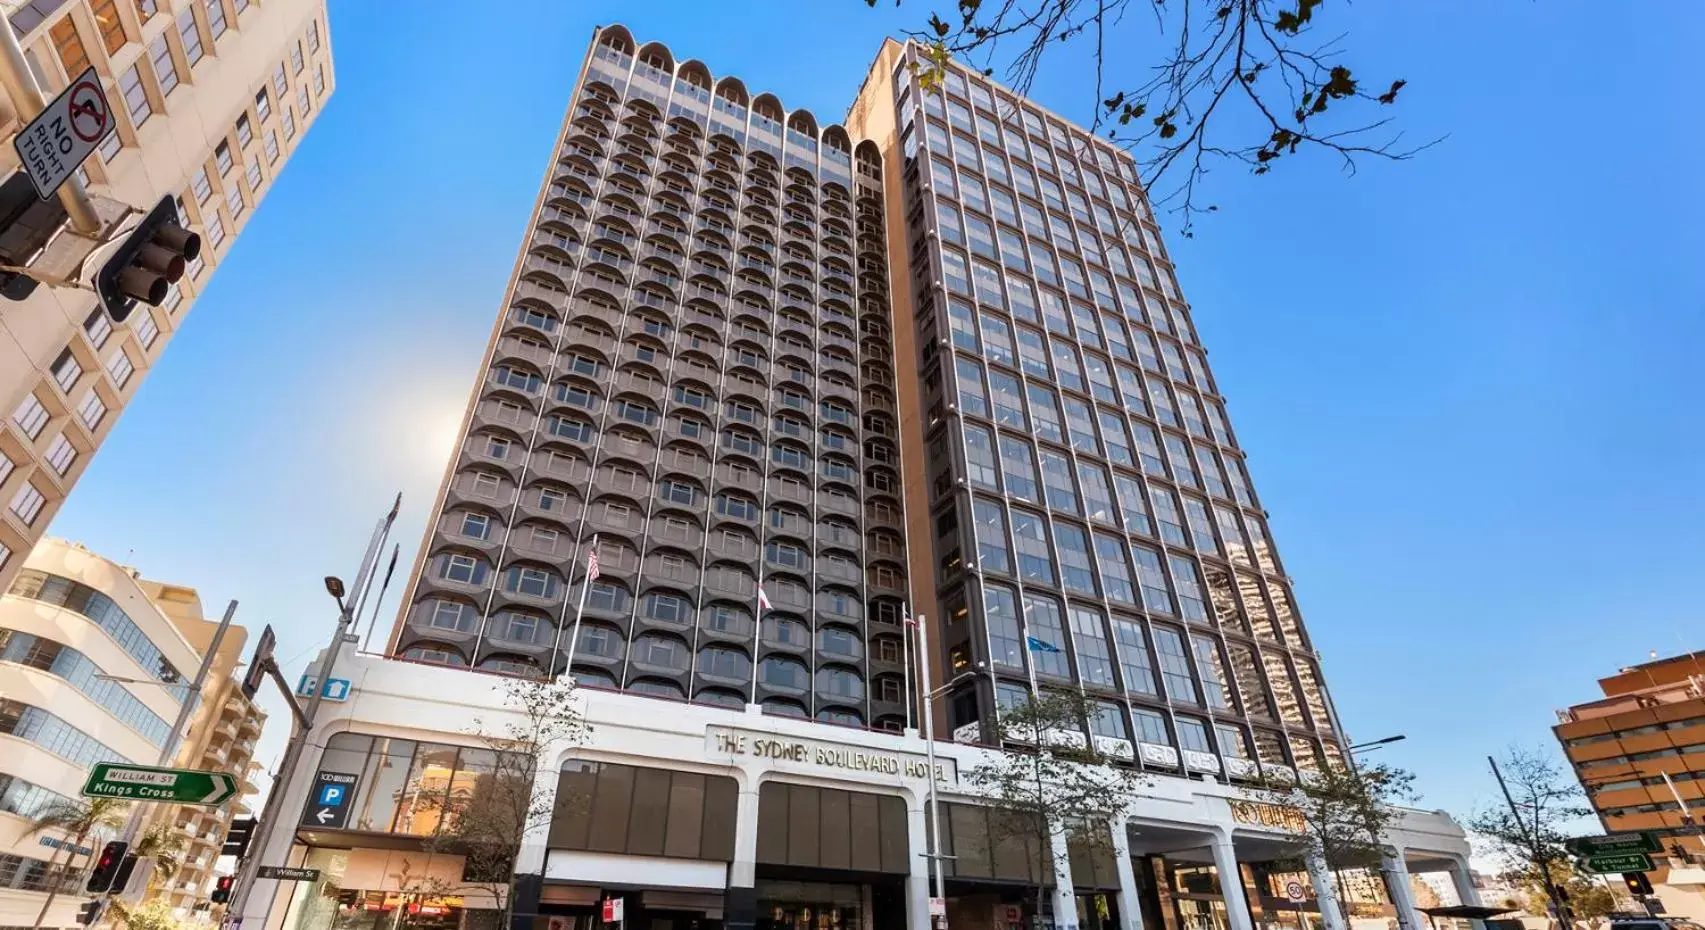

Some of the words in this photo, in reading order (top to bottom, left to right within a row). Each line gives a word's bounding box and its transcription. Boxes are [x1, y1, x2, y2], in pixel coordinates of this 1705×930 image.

[50, 116, 73, 155] NO
[23, 136, 53, 186] TURN
[34, 124, 65, 174] RIGHT
[716, 734, 746, 755] THE
[753, 739, 809, 762] SYDNEY
[816, 747, 899, 775] BOULEVARD
[905, 760, 948, 782] HOTEL
[109, 771, 155, 782] WILLIAM
[93, 783, 133, 796] Kings
[139, 786, 174, 797] Cross
[325, 788, 340, 802] P
[1289, 886, 1300, 895] 50
